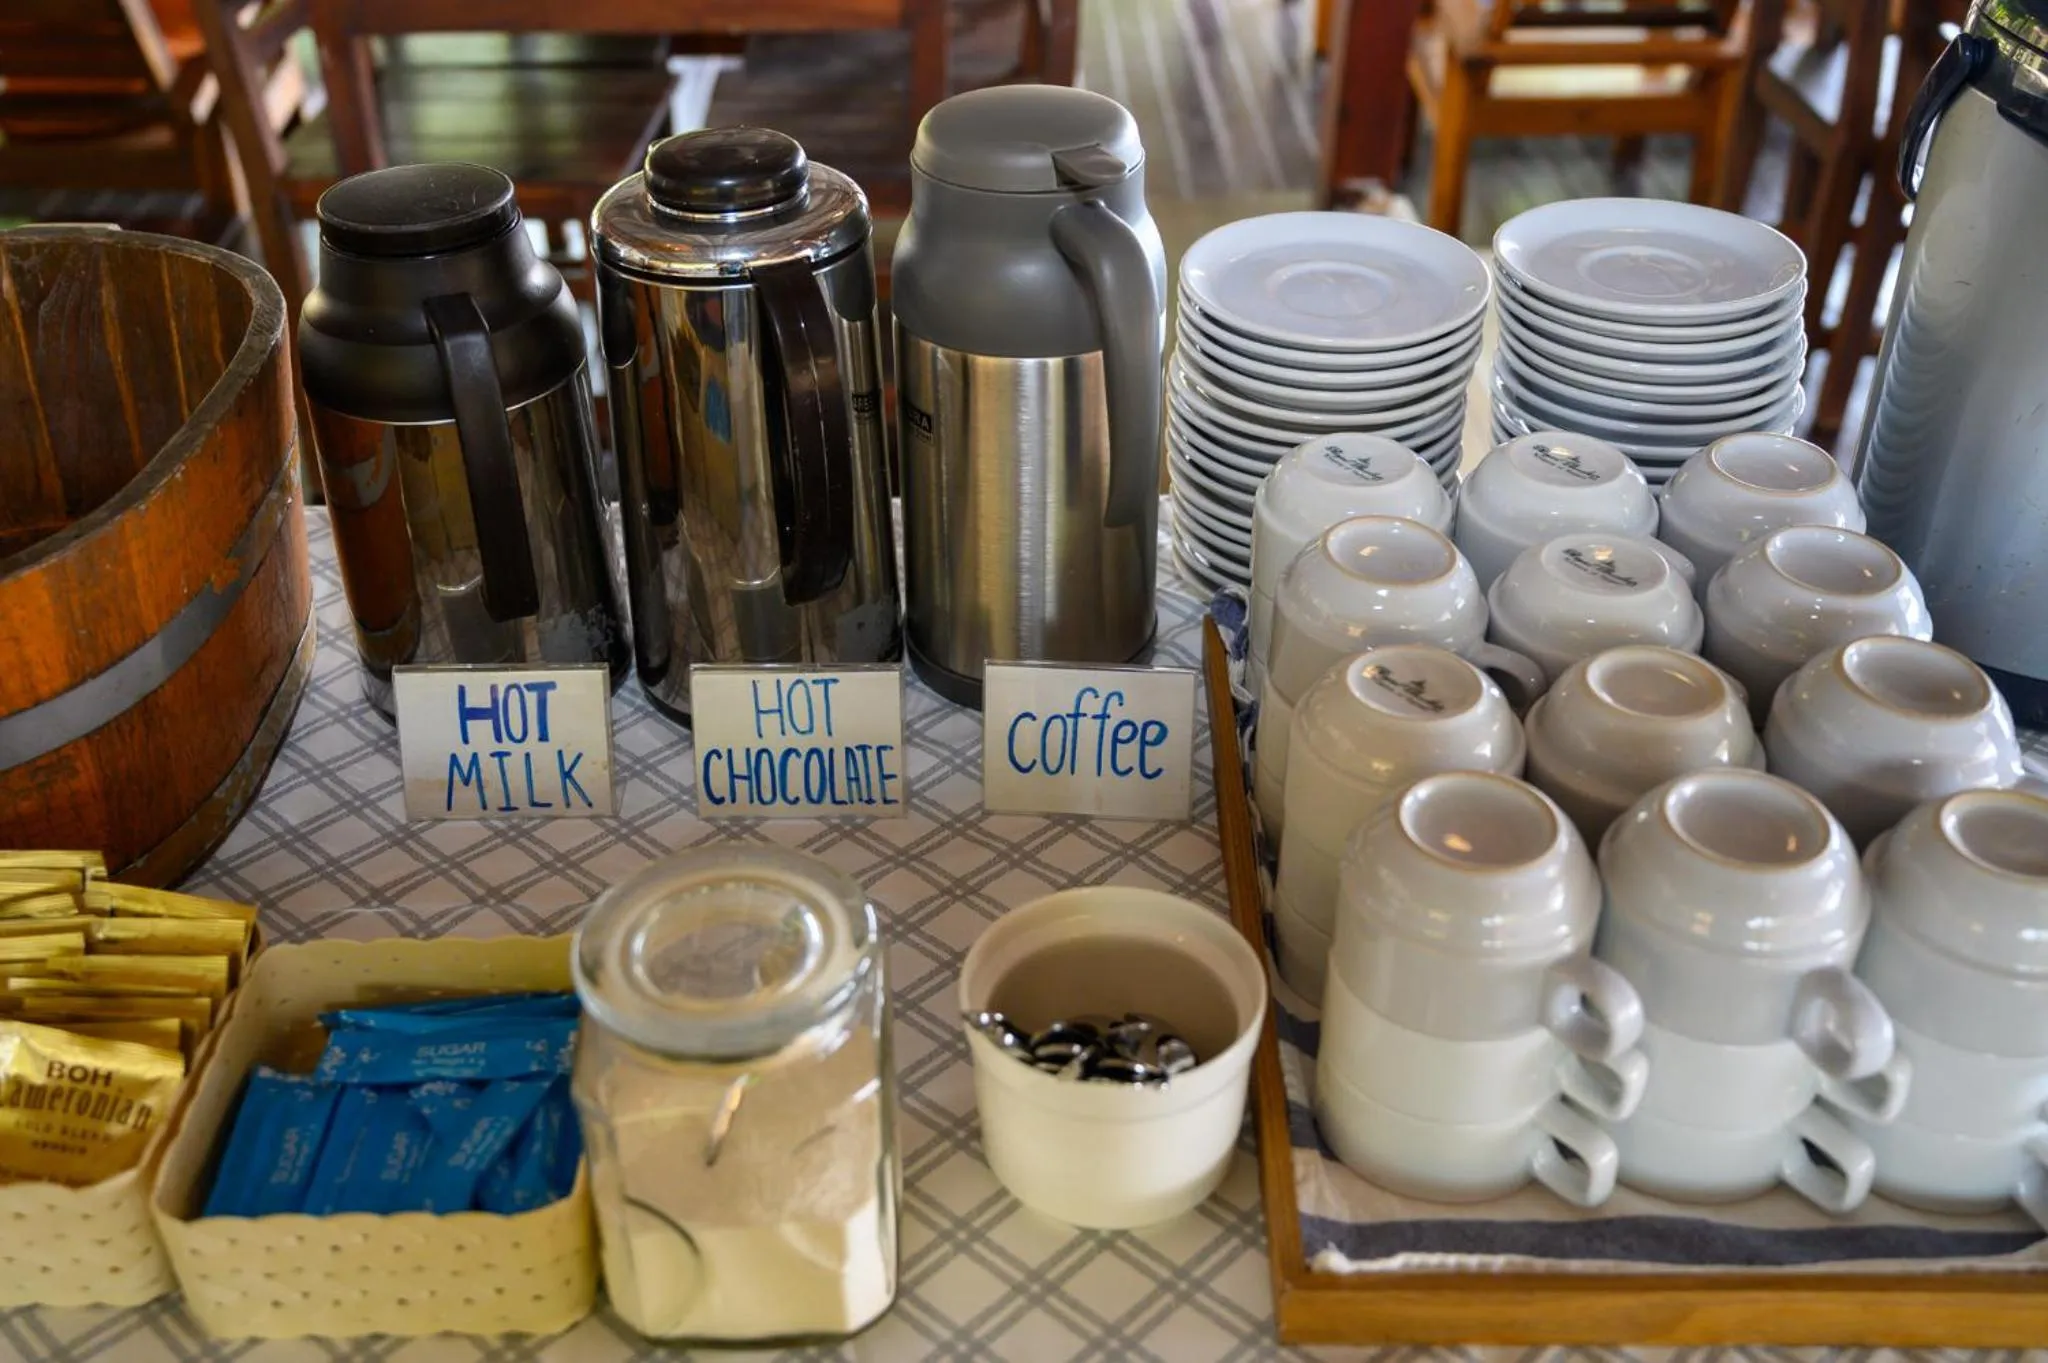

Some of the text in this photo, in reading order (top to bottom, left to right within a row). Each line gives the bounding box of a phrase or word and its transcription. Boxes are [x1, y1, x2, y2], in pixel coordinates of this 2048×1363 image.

[457, 681, 556, 744] HOT
[752, 678, 839, 738] HOT
[446, 749, 593, 812] MILK
[702, 744, 898, 806] CHOCOLATE
[47, 1060, 113, 1087] BOH
[416, 1041, 487, 1058] SUGAR
[0, 1079, 153, 1132] ameronian
